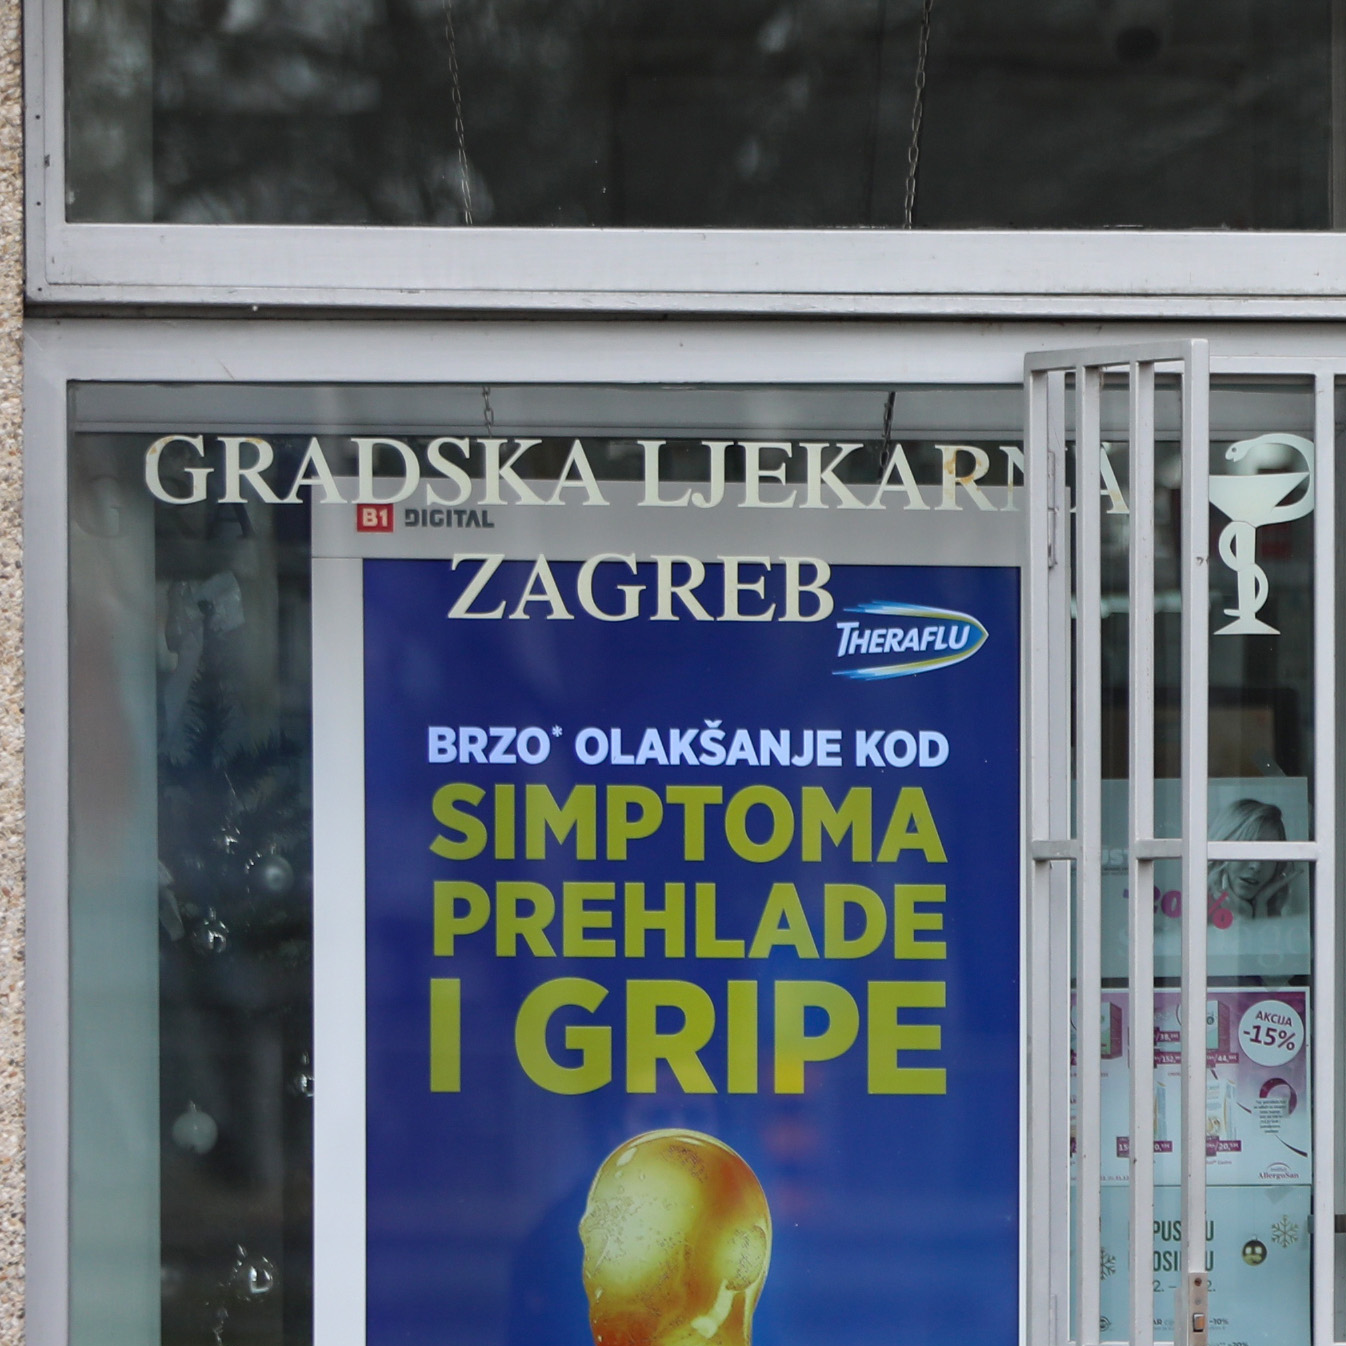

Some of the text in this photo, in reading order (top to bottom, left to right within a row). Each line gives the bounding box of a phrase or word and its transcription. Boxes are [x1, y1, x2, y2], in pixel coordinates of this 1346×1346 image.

[144, 435, 610, 506] GRADSKA
[362, 508, 495, 528] B1 DIGITAL
[448, 553, 834, 622] ZAGREB
[836, 621, 970, 657] THERAFLU
[574, 720, 842, 767] OLAKŠANJE
[855, 730, 950, 768] KOD
[430, 783, 948, 863] SIMPTOMA
[433, 881, 947, 959] PREHLADE
[430, 977, 947, 1095] I GRIPE
[1243, 1025, 1296, 1051] -15%
[1255, 1010, 1293, 1028] AKCIJA
